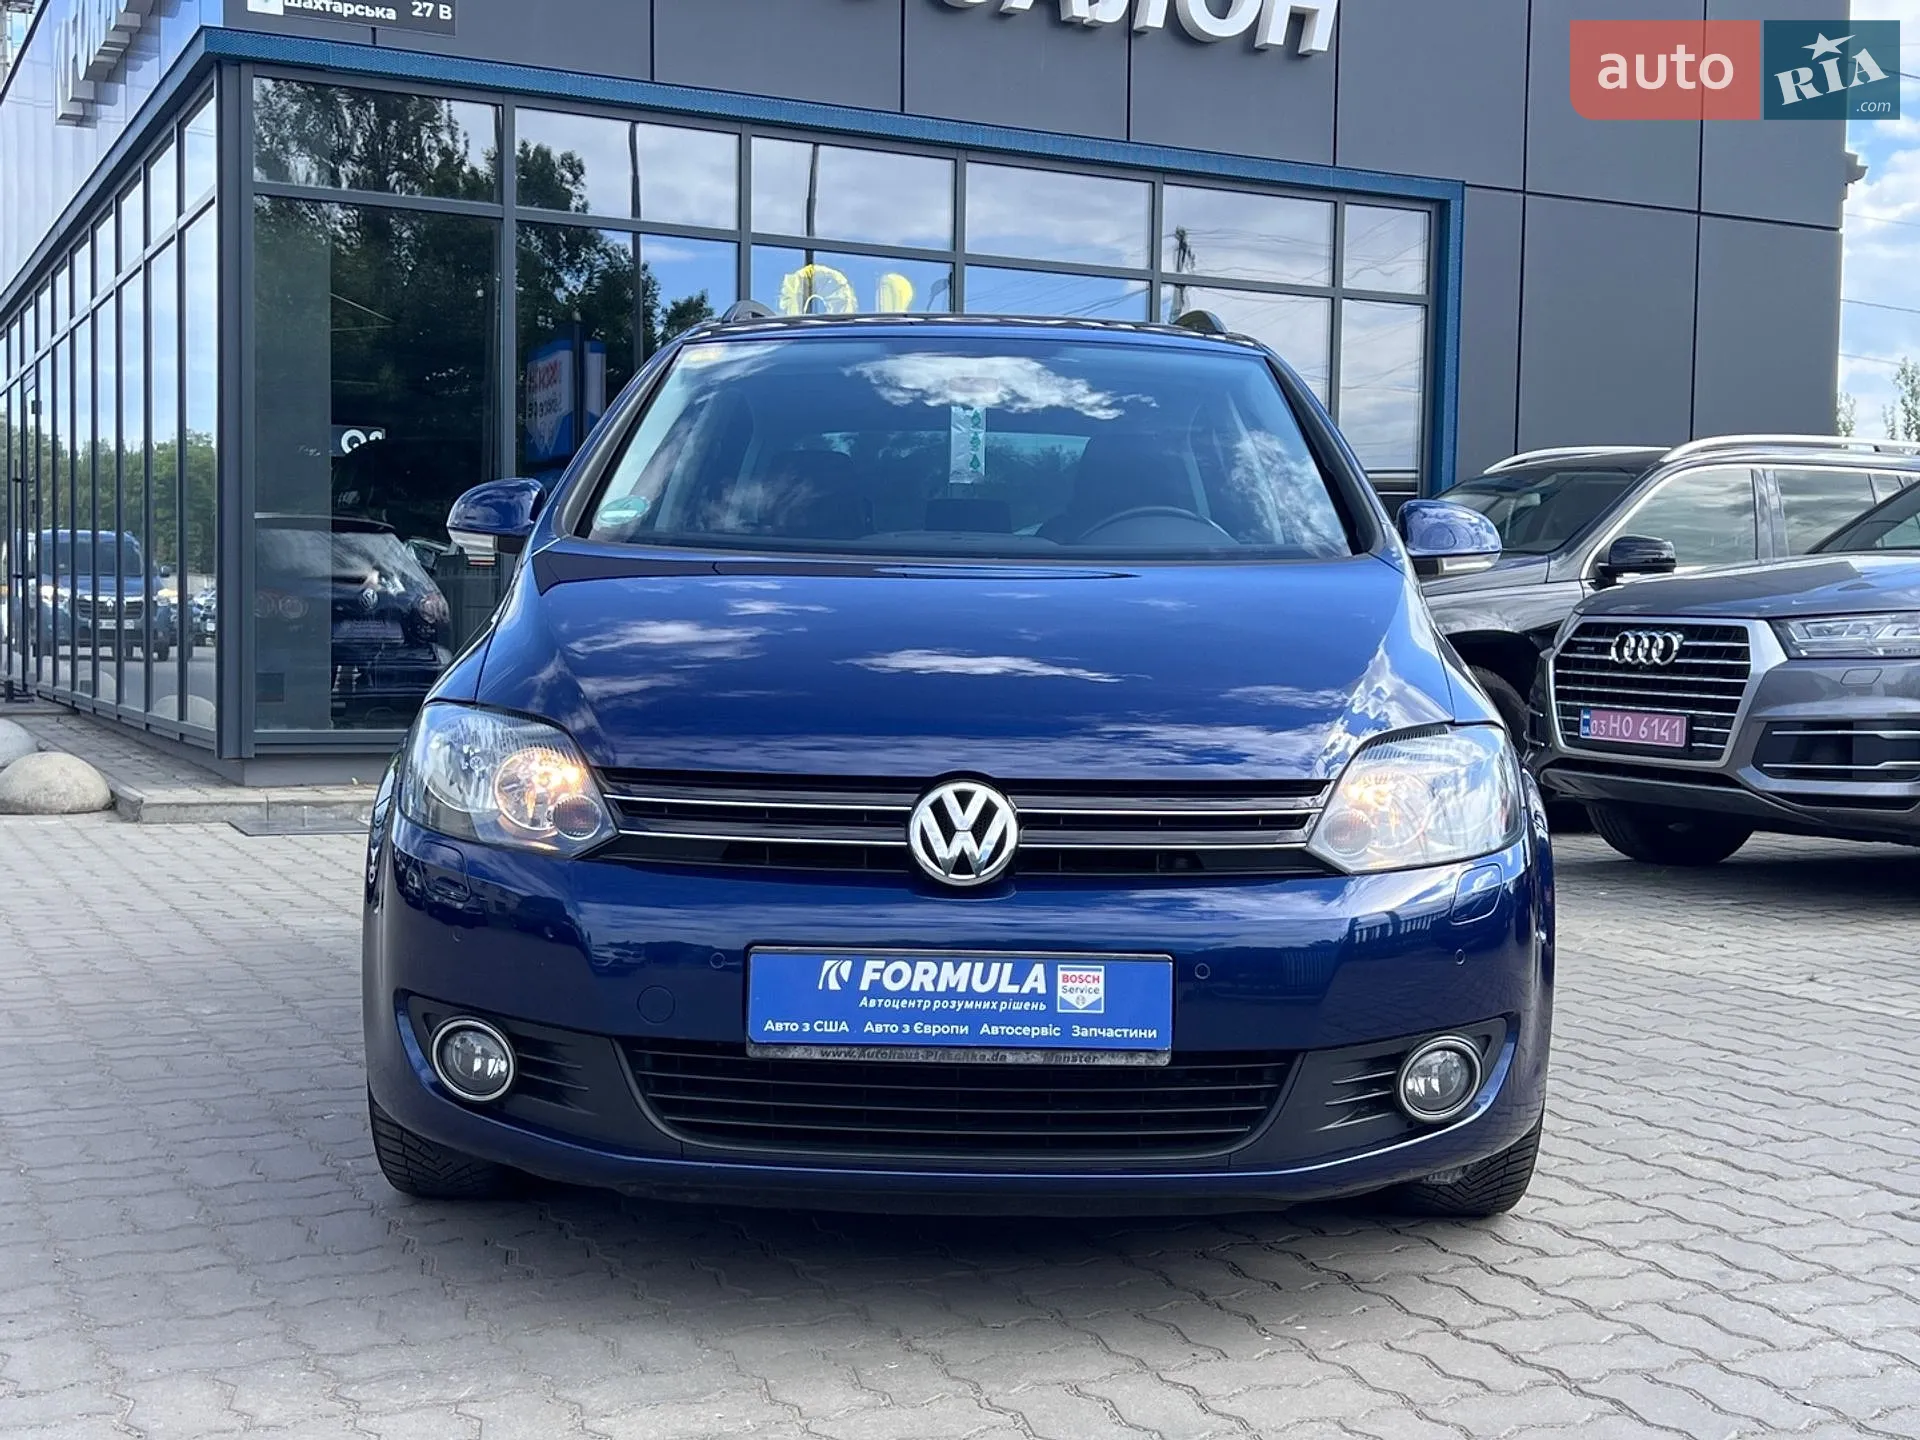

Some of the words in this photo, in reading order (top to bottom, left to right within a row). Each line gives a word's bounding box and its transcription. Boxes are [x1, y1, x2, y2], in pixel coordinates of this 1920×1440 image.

[411, 1, 434, 18] 27
[1638, 716, 1681, 743] 6141
[859, 960, 1047, 995] FORMULA
[1061, 974, 1100, 984] BOSCH
[1061, 985, 1100, 995] Service
[859, 996, 931, 1011] Автоцентр
[932, 999, 998, 1012] розумних
[999, 999, 1047, 1013] рішень
[763, 1019, 799, 1032] Авто
[802, 1022, 810, 1032] з
[813, 1021, 849, 1032] США
[863, 1021, 899, 1034] Авто
[902, 1024, 910, 1034] з
[913, 1022, 969, 1037] Європи
[979, 1023, 1061, 1039] Автосервіс
[1071, 1025, 1157, 1039] Запчастини
